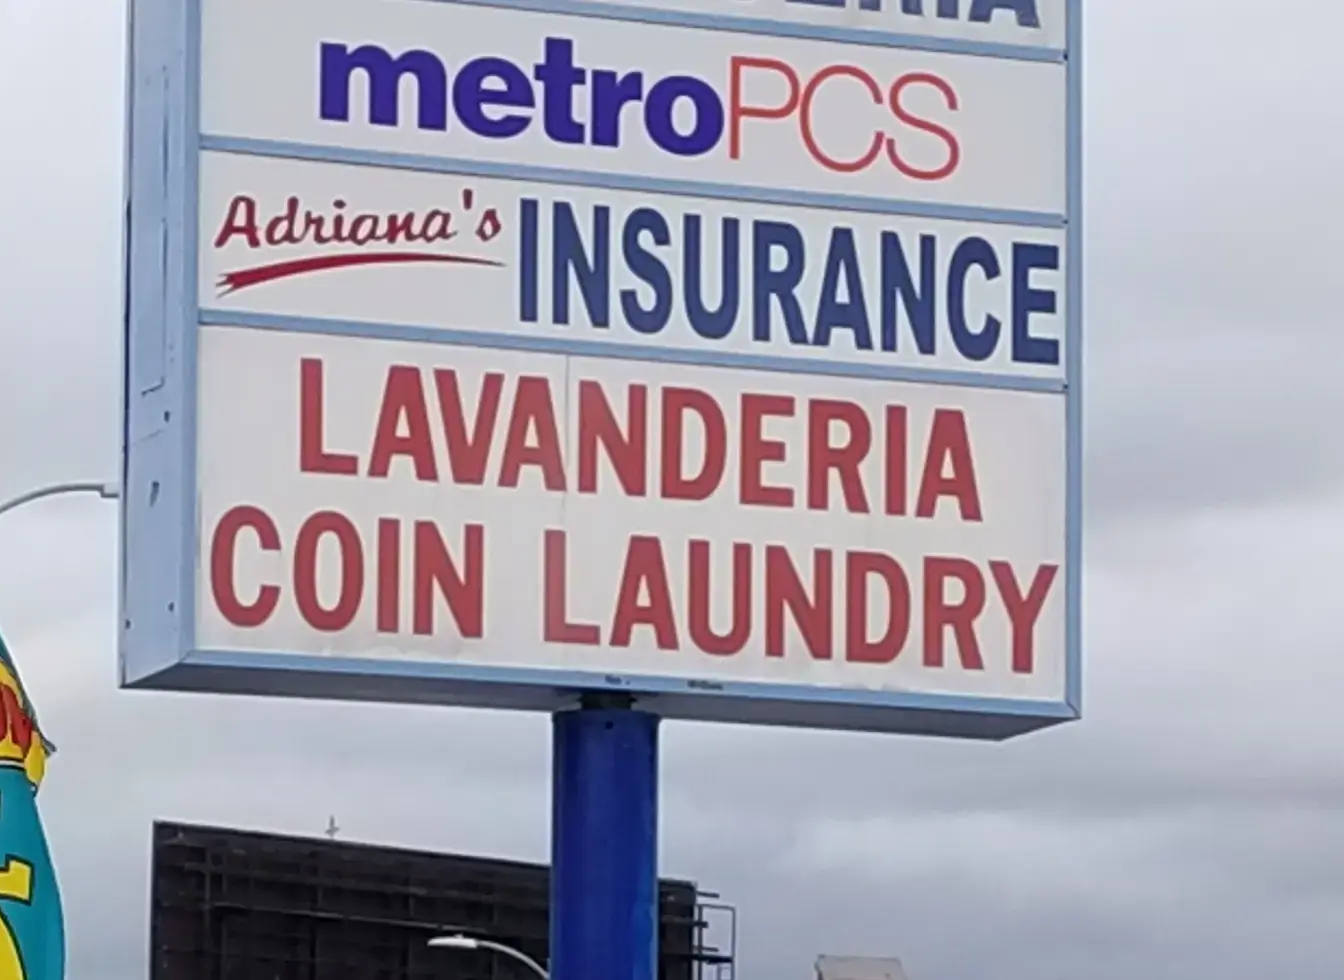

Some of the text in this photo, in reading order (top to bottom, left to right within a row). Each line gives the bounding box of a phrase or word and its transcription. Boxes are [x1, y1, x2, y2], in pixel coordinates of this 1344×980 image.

[319, 37, 961, 180] metroPCS
[214, 189, 1061, 367] Adriana's INSURANCE
[299, 357, 983, 523] LAVANDERIA
[210, 505, 1059, 676] COIN LAUNDRY
